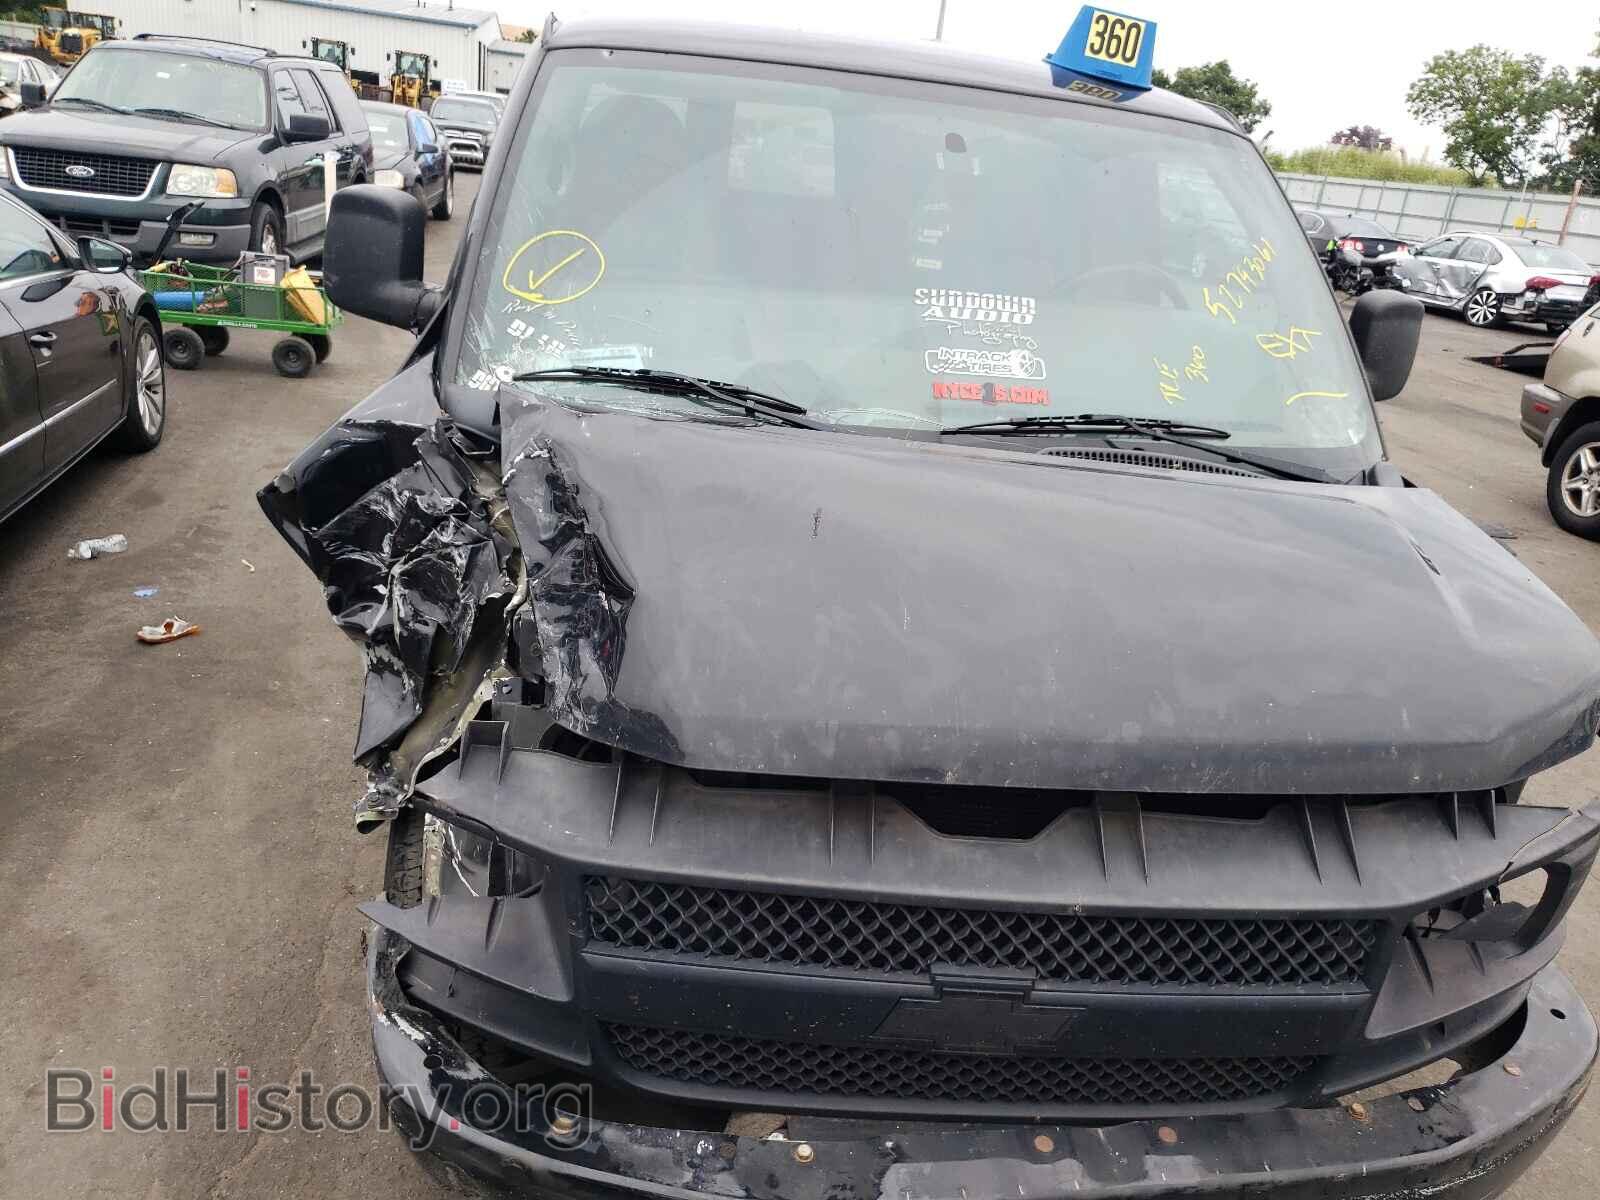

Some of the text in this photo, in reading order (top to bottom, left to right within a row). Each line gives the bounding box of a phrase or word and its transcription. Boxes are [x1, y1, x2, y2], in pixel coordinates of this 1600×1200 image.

[1089, 14, 1141, 63] 360
[921, 306, 1034, 325] AUDIO
[938, 347, 1012, 362] INTRACK
[970, 361, 1012, 374] TIRES
